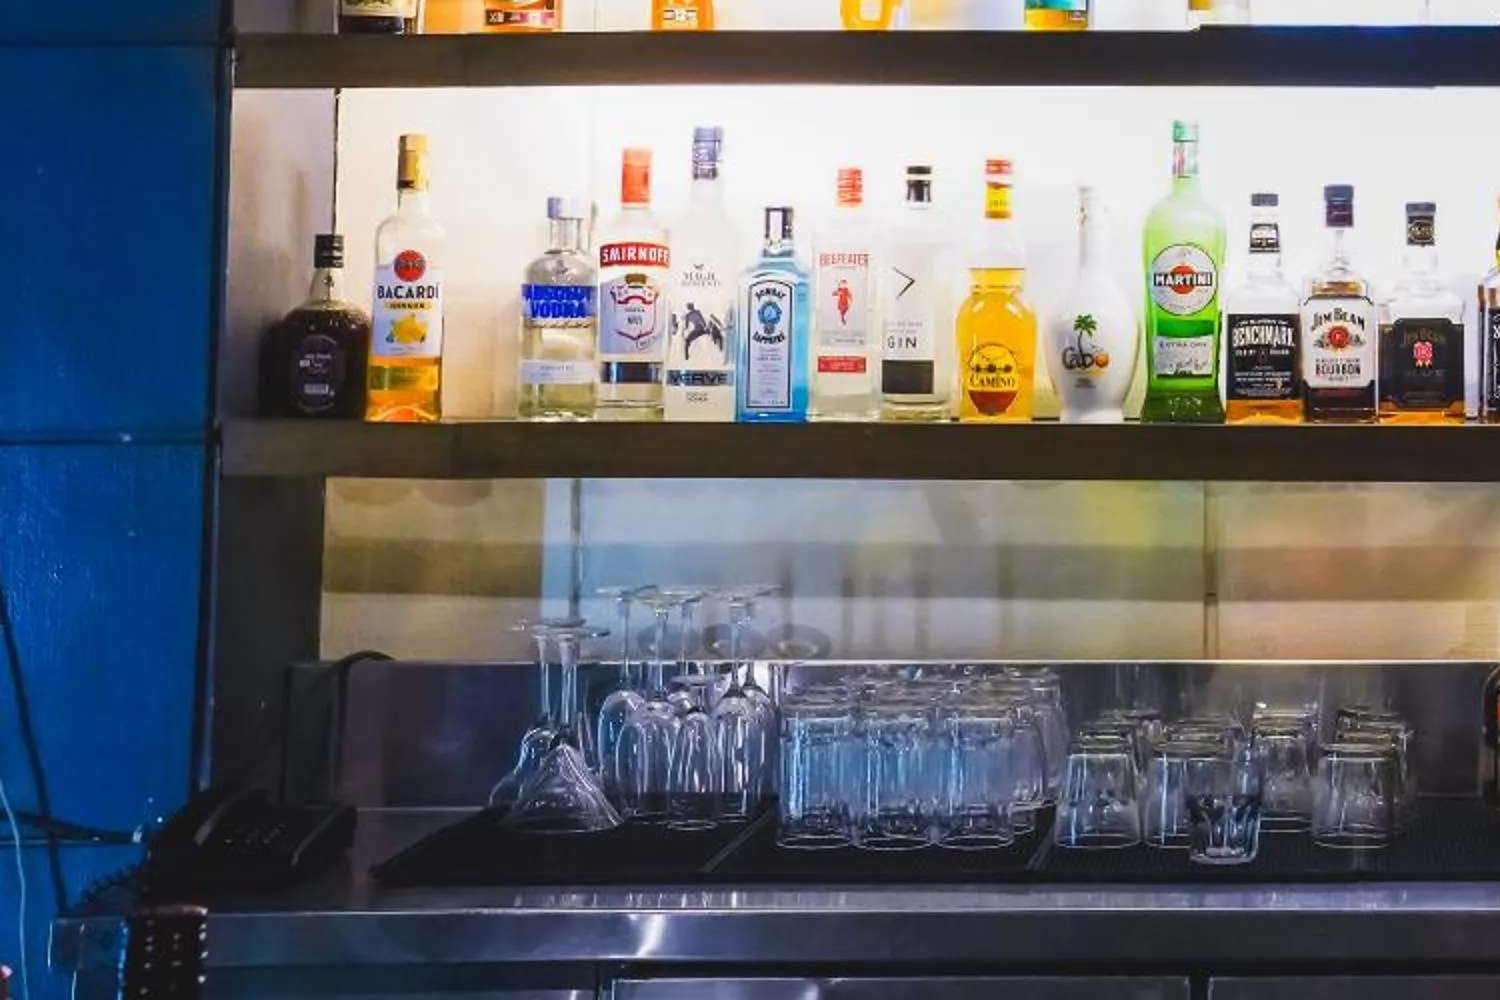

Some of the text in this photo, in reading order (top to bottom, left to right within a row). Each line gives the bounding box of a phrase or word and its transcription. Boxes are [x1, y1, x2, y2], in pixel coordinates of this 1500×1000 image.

[601, 246, 671, 265] SMIRNOFF
[819, 252, 870, 267] BEEFEATER
[1153, 272, 1213, 287] MARTINI
[754, 287, 787, 301] BOMBAY
[1311, 307, 1366, 331] JIM BEAM
[887, 335, 918, 349] GIN
